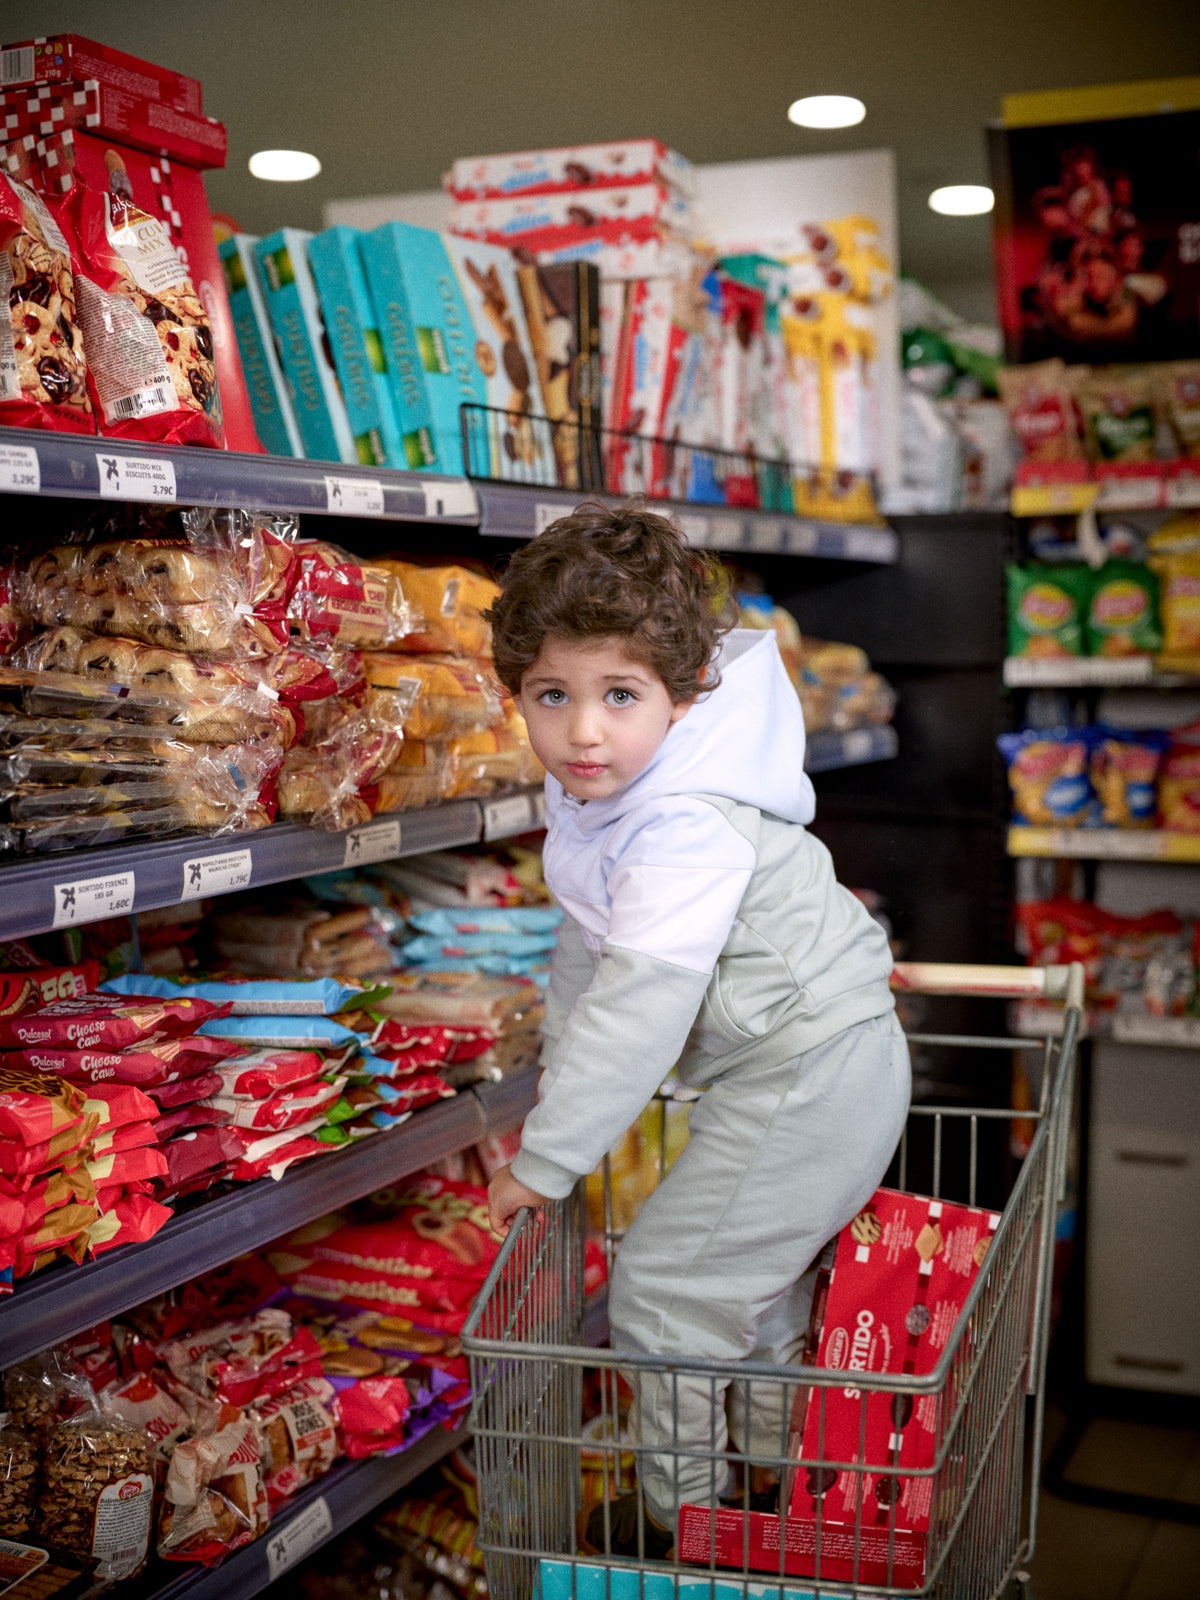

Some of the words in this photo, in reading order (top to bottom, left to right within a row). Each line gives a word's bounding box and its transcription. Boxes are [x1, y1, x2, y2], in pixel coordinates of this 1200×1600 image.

[137, 236, 166, 256] MIX
[105, 878, 129, 889] FIRENZE
[105, 889, 114, 898] GR
[17, 1028, 52, 1041] Dulcesol
[67, 1020, 106, 1041] Cheese
[30, 1055, 65, 1069] Dulcesol
[80, 1055, 122, 1072] Cheese
[843, 1309, 874, 1401] SRTIDO
